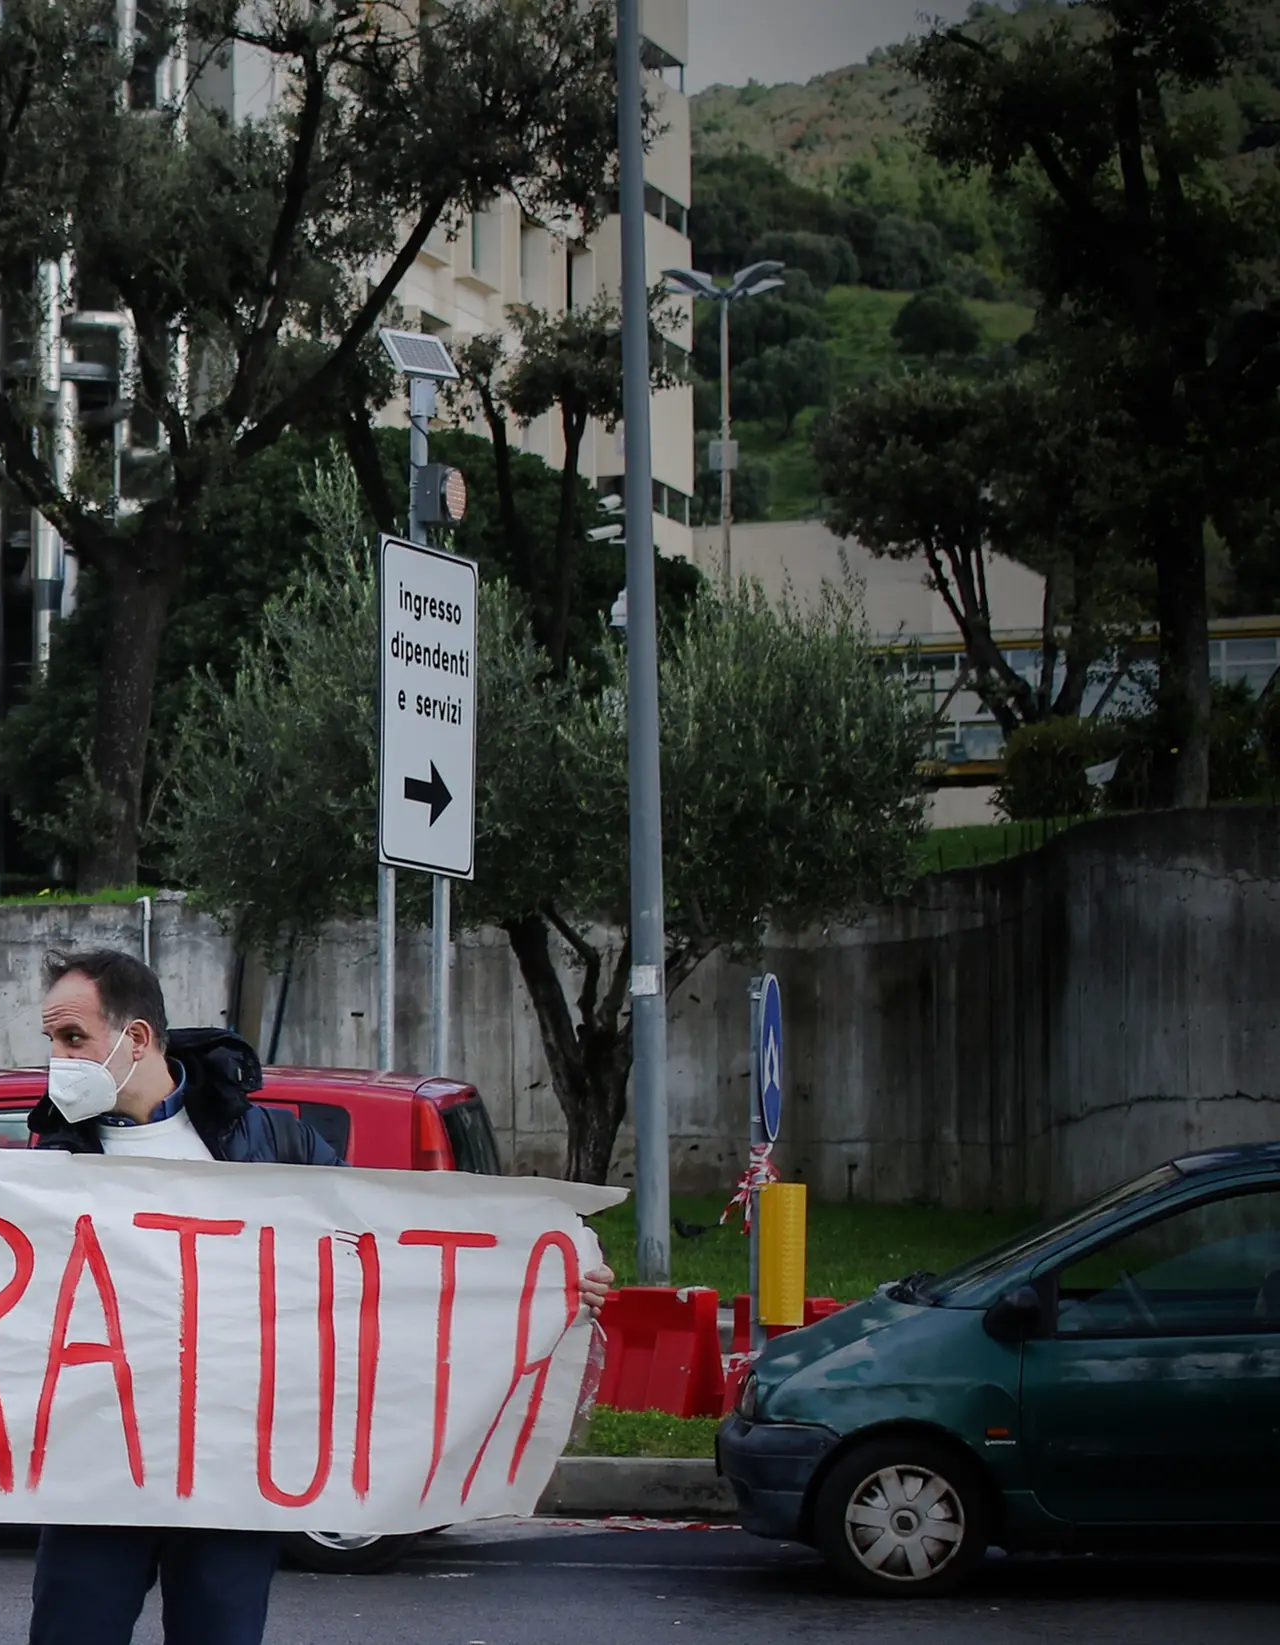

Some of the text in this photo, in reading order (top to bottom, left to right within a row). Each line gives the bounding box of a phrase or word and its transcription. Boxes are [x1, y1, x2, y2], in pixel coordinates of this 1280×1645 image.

[399, 581, 462, 625] ingresso
[391, 631, 470, 678] dipendenti
[397, 689, 463, 726] e servizi
